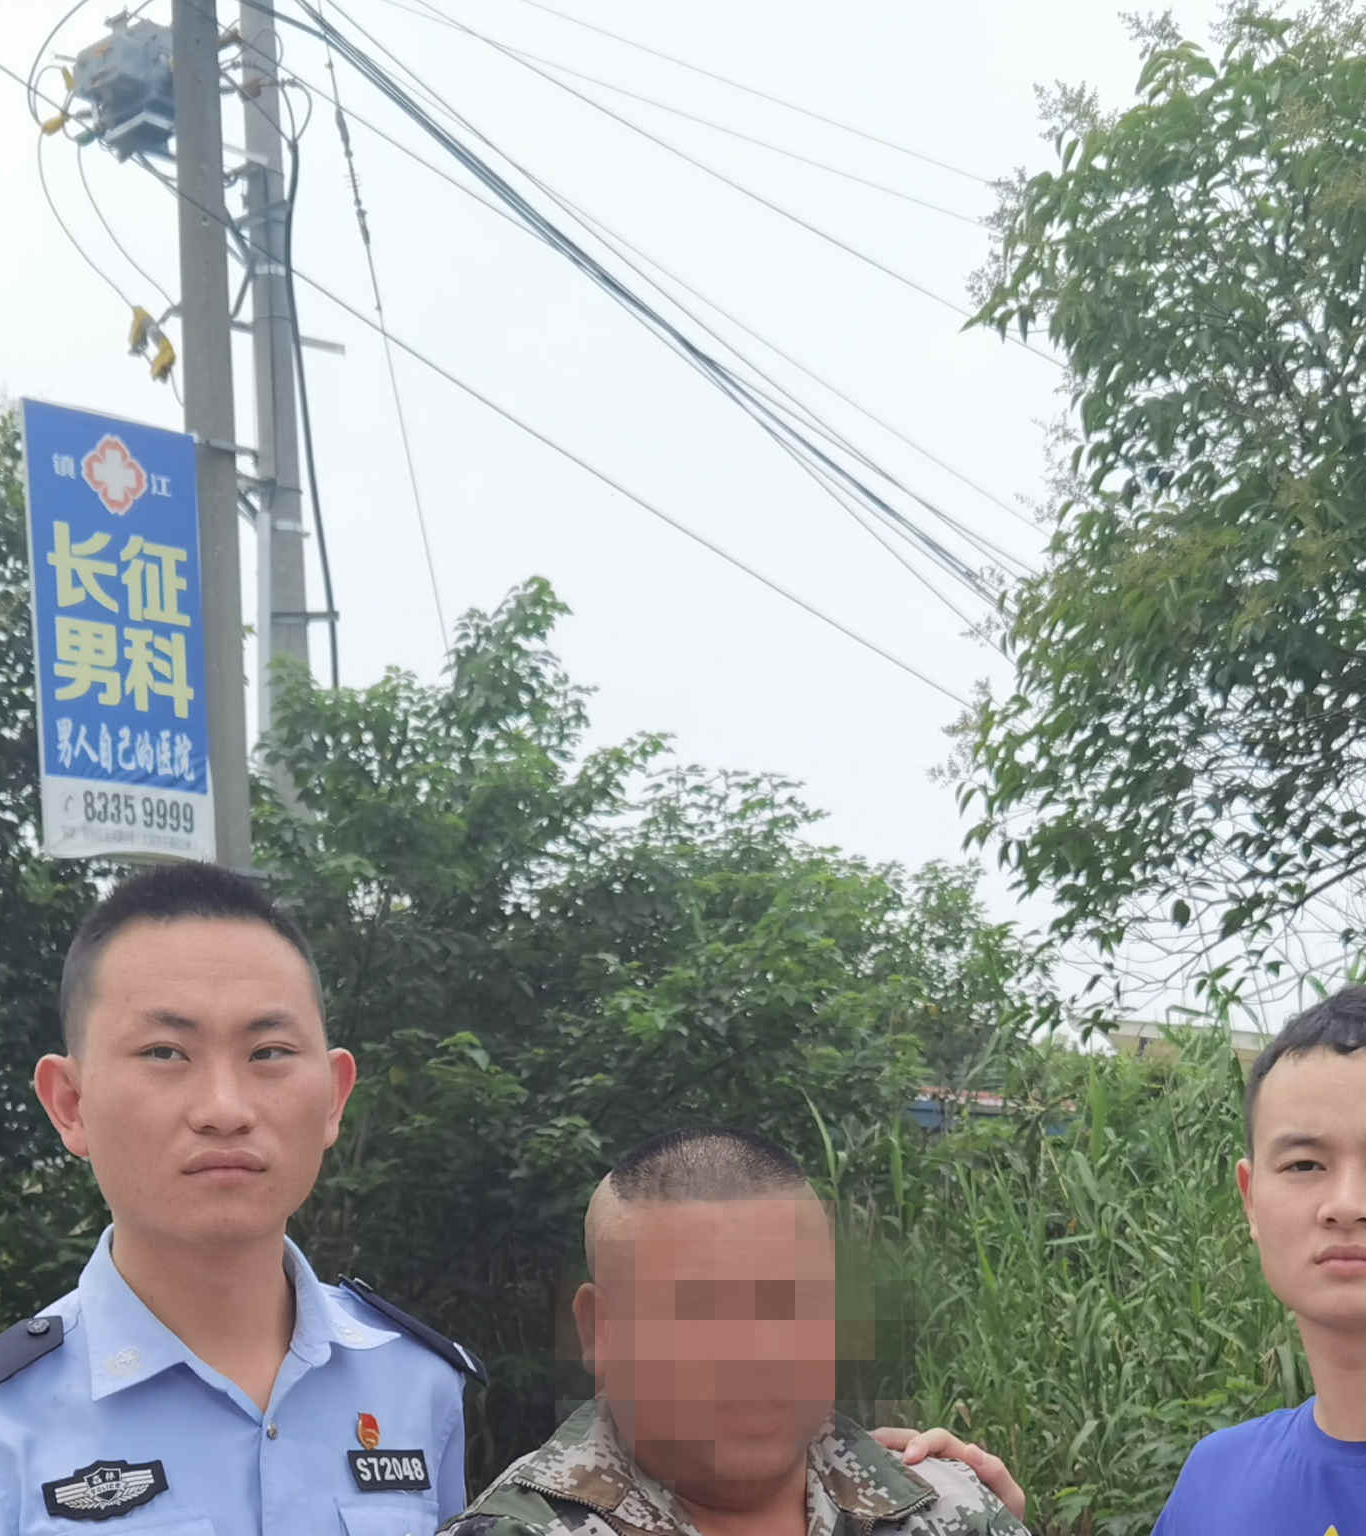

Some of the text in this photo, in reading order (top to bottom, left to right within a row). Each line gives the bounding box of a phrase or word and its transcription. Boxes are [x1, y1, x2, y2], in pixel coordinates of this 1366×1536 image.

[149, 472, 172, 498] 江
[46, 520, 191, 628] 长征
[53, 615, 194, 719] 男科
[56, 717, 195, 782] 男人自己的医院
[84, 790, 195, 833] 8335 9999
[355, 1456, 425, 1482] S72048
